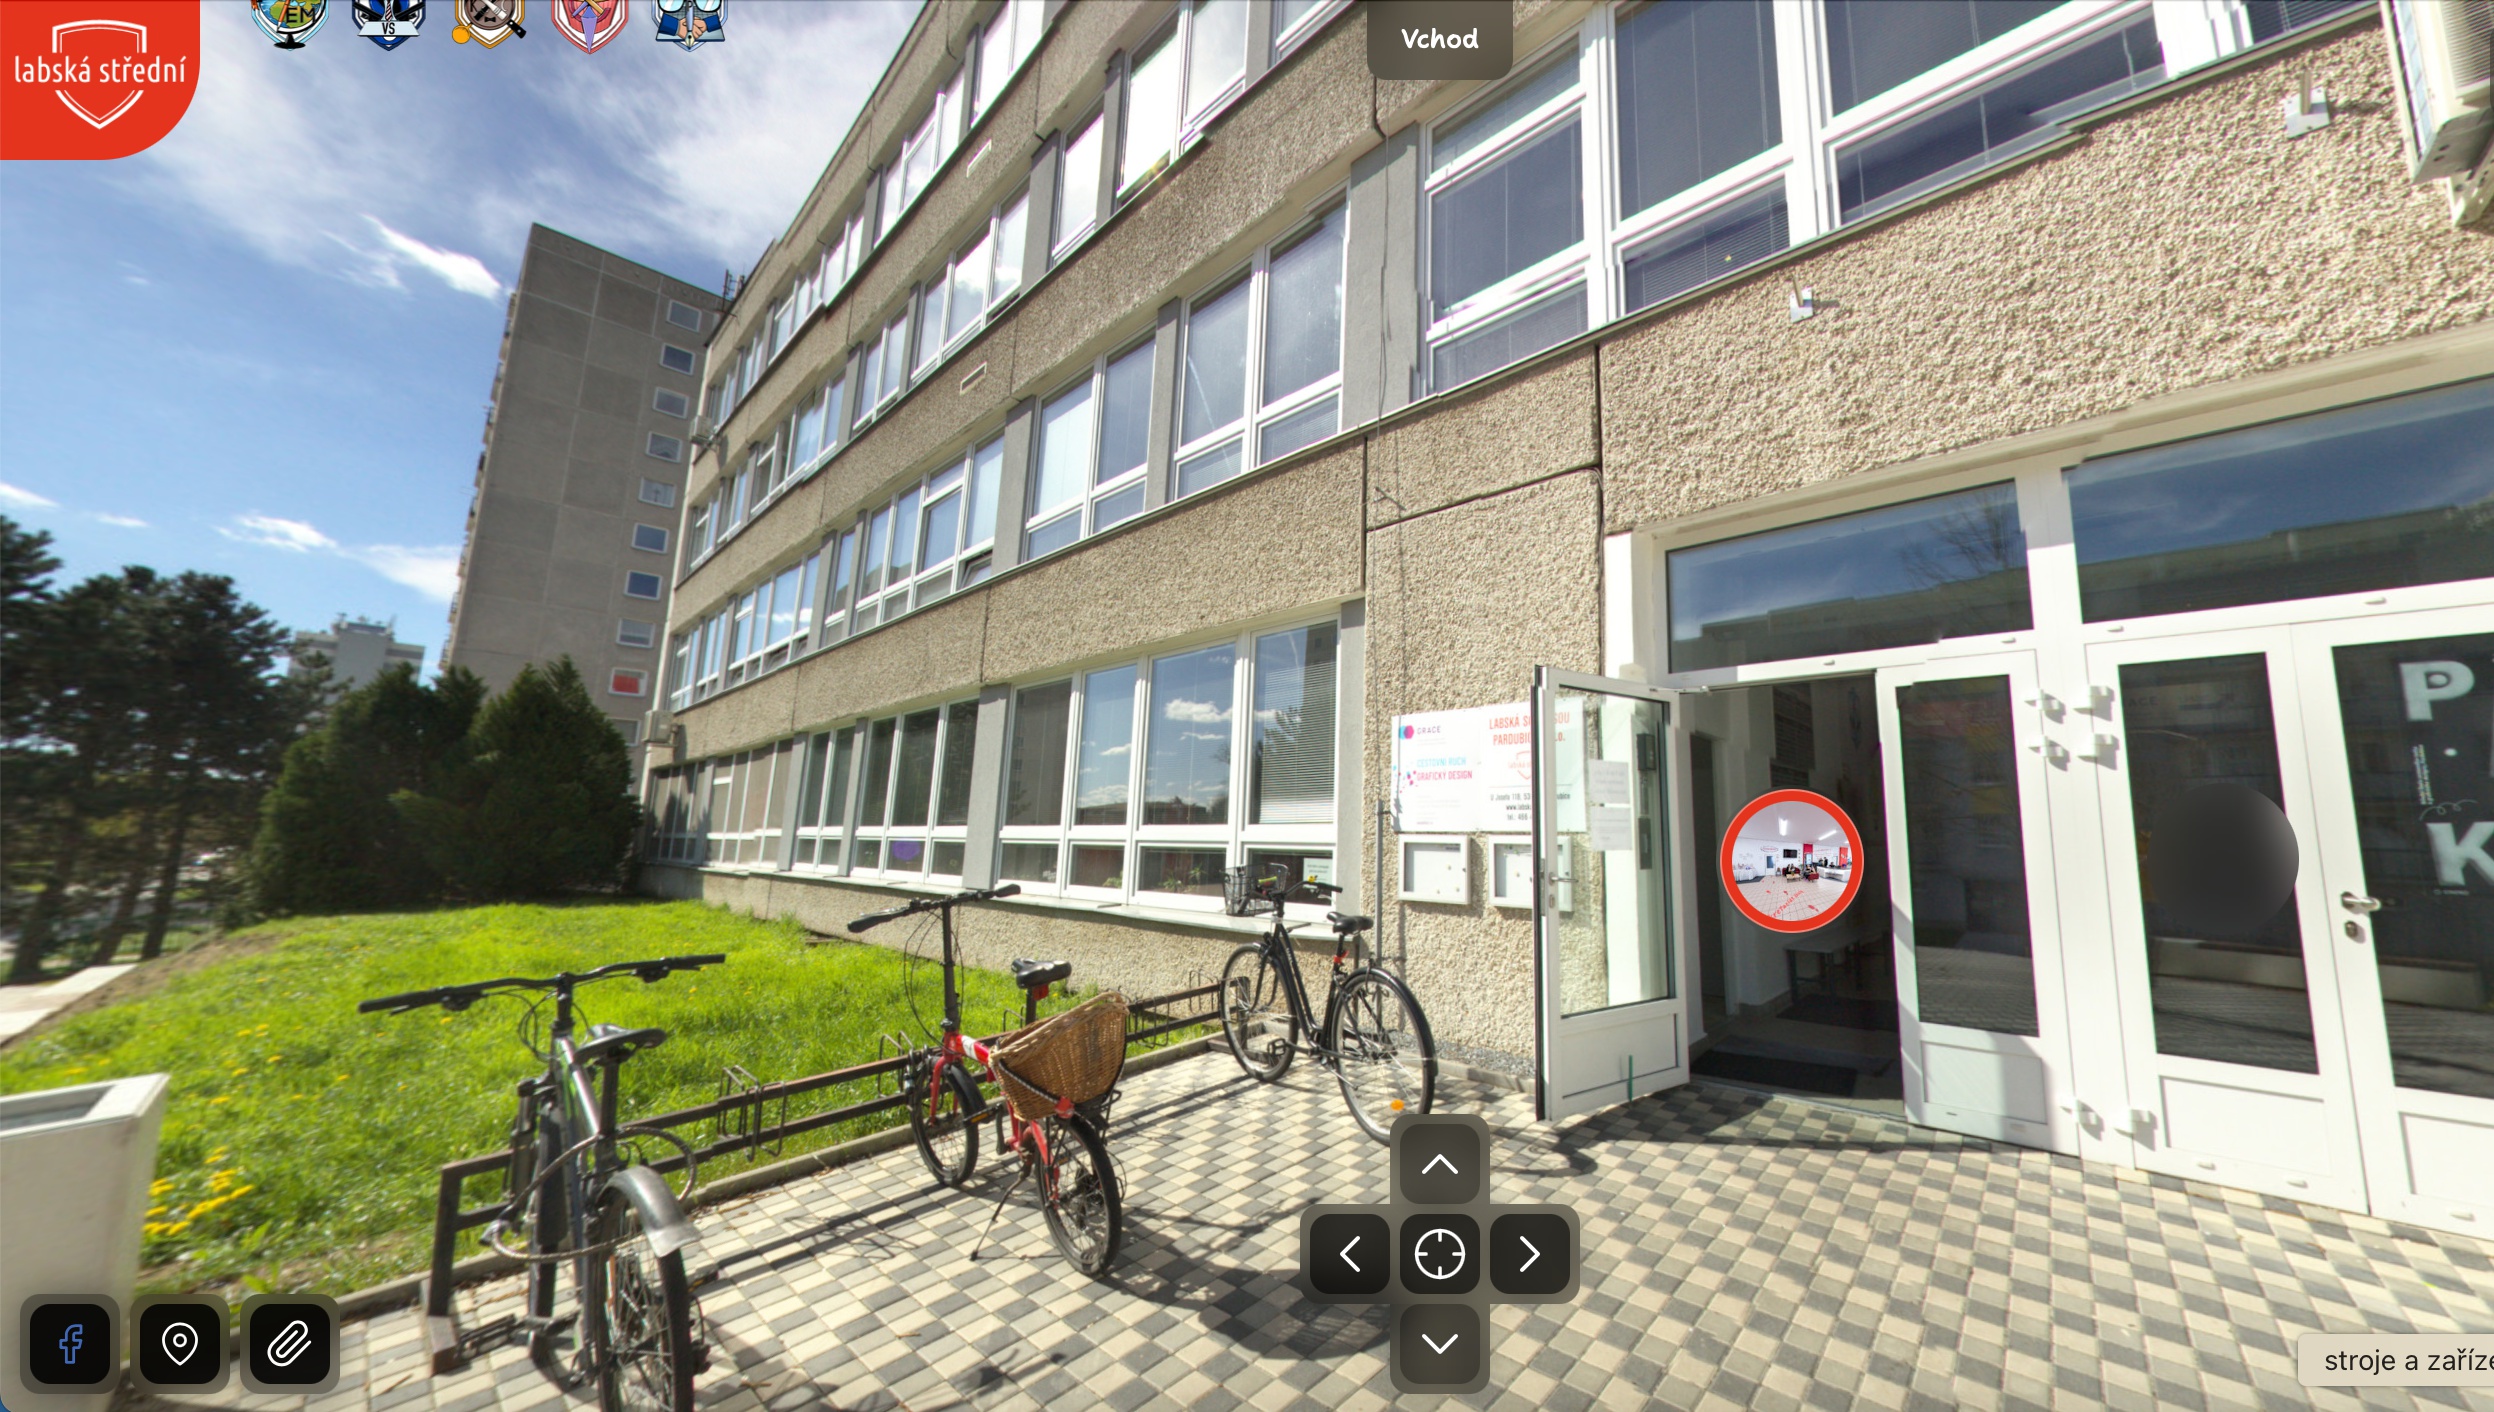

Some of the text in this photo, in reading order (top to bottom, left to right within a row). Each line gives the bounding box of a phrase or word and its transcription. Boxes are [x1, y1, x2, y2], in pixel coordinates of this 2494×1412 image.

[2399, 661, 2475, 721] P
[1489, 713, 1520, 730] LABSKÁ
[1417, 725, 1441, 734] GRACE
[1448, 770, 1472, 780] DESIGN
